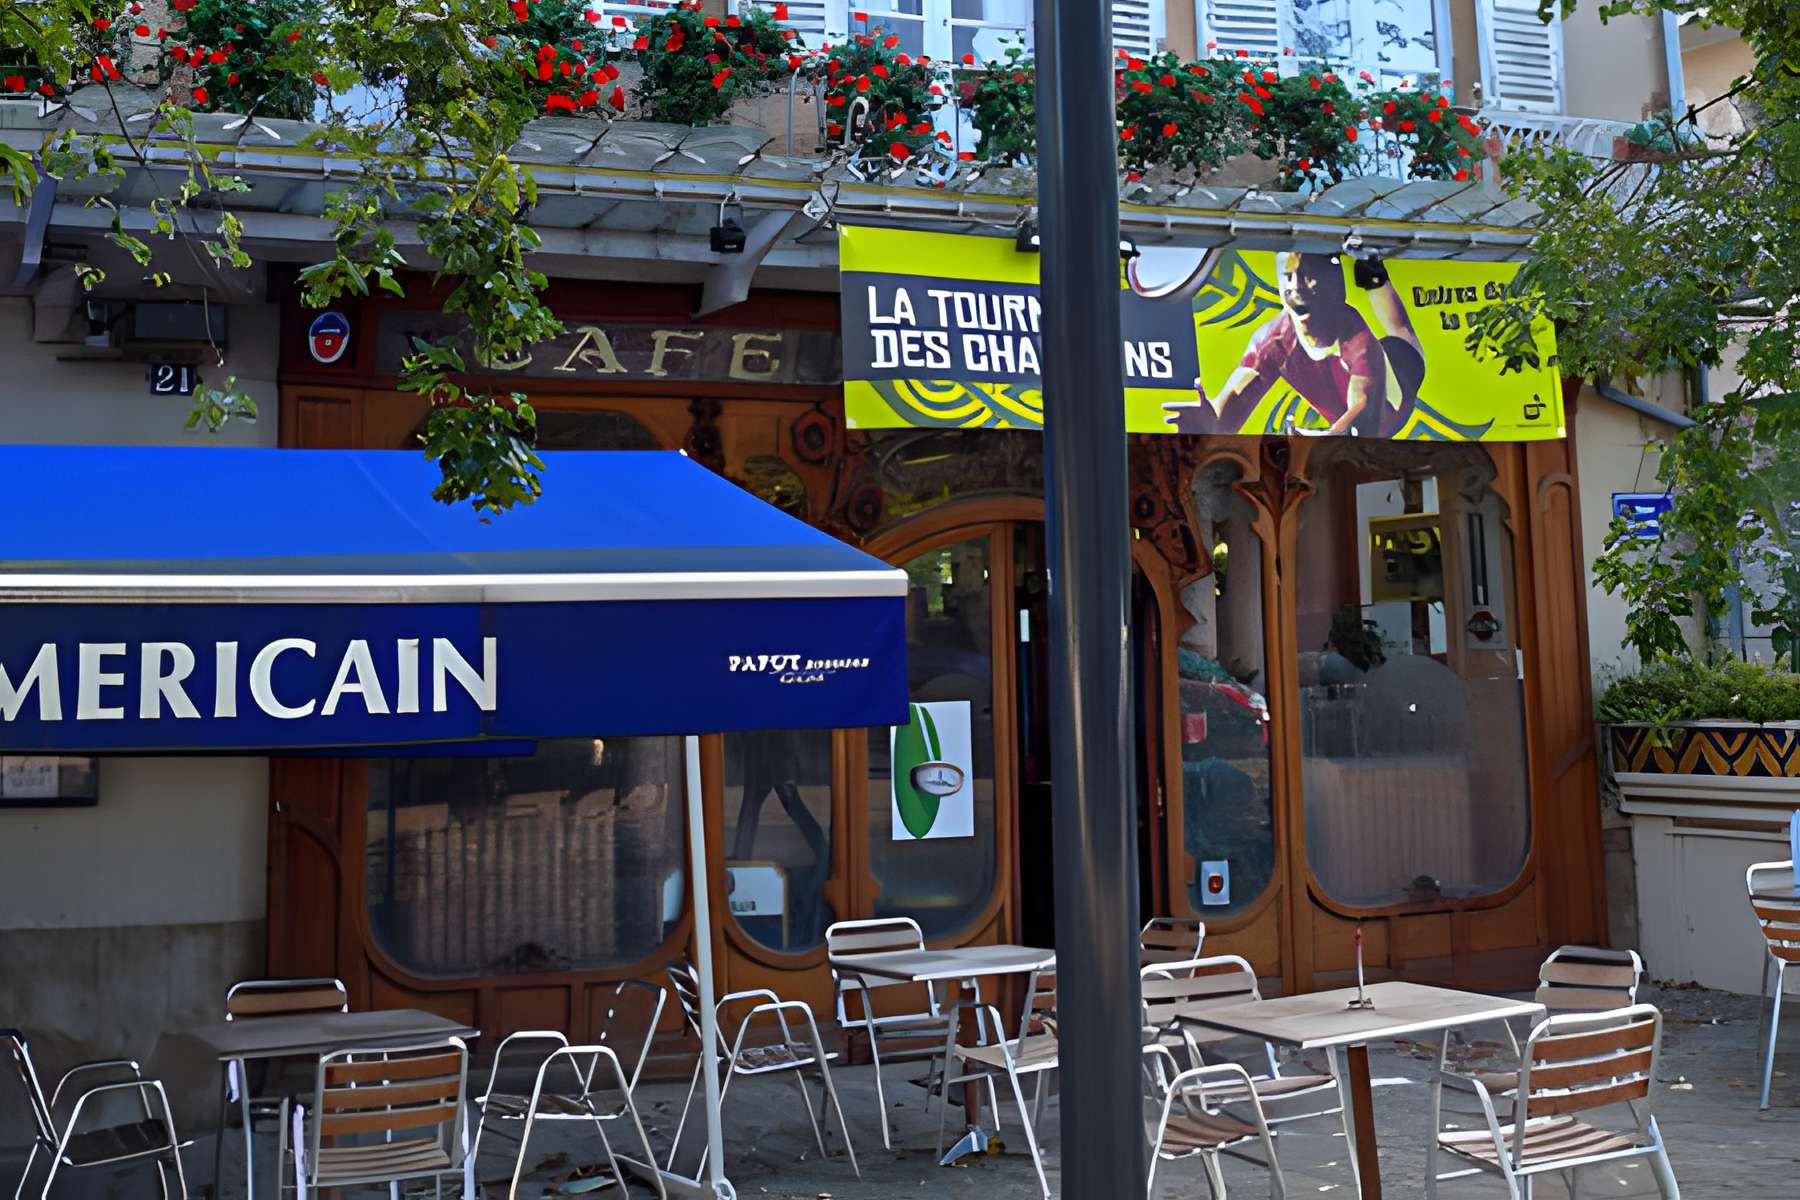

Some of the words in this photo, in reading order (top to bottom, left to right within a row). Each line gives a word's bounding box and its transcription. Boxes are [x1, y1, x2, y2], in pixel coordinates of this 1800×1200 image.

[868, 285, 915, 326] LA
[928, 289, 1042, 333] TOURN
[870, 329, 951, 369] DES
[962, 333, 1174, 379] CHANS
[155, 364, 189, 393] 21
